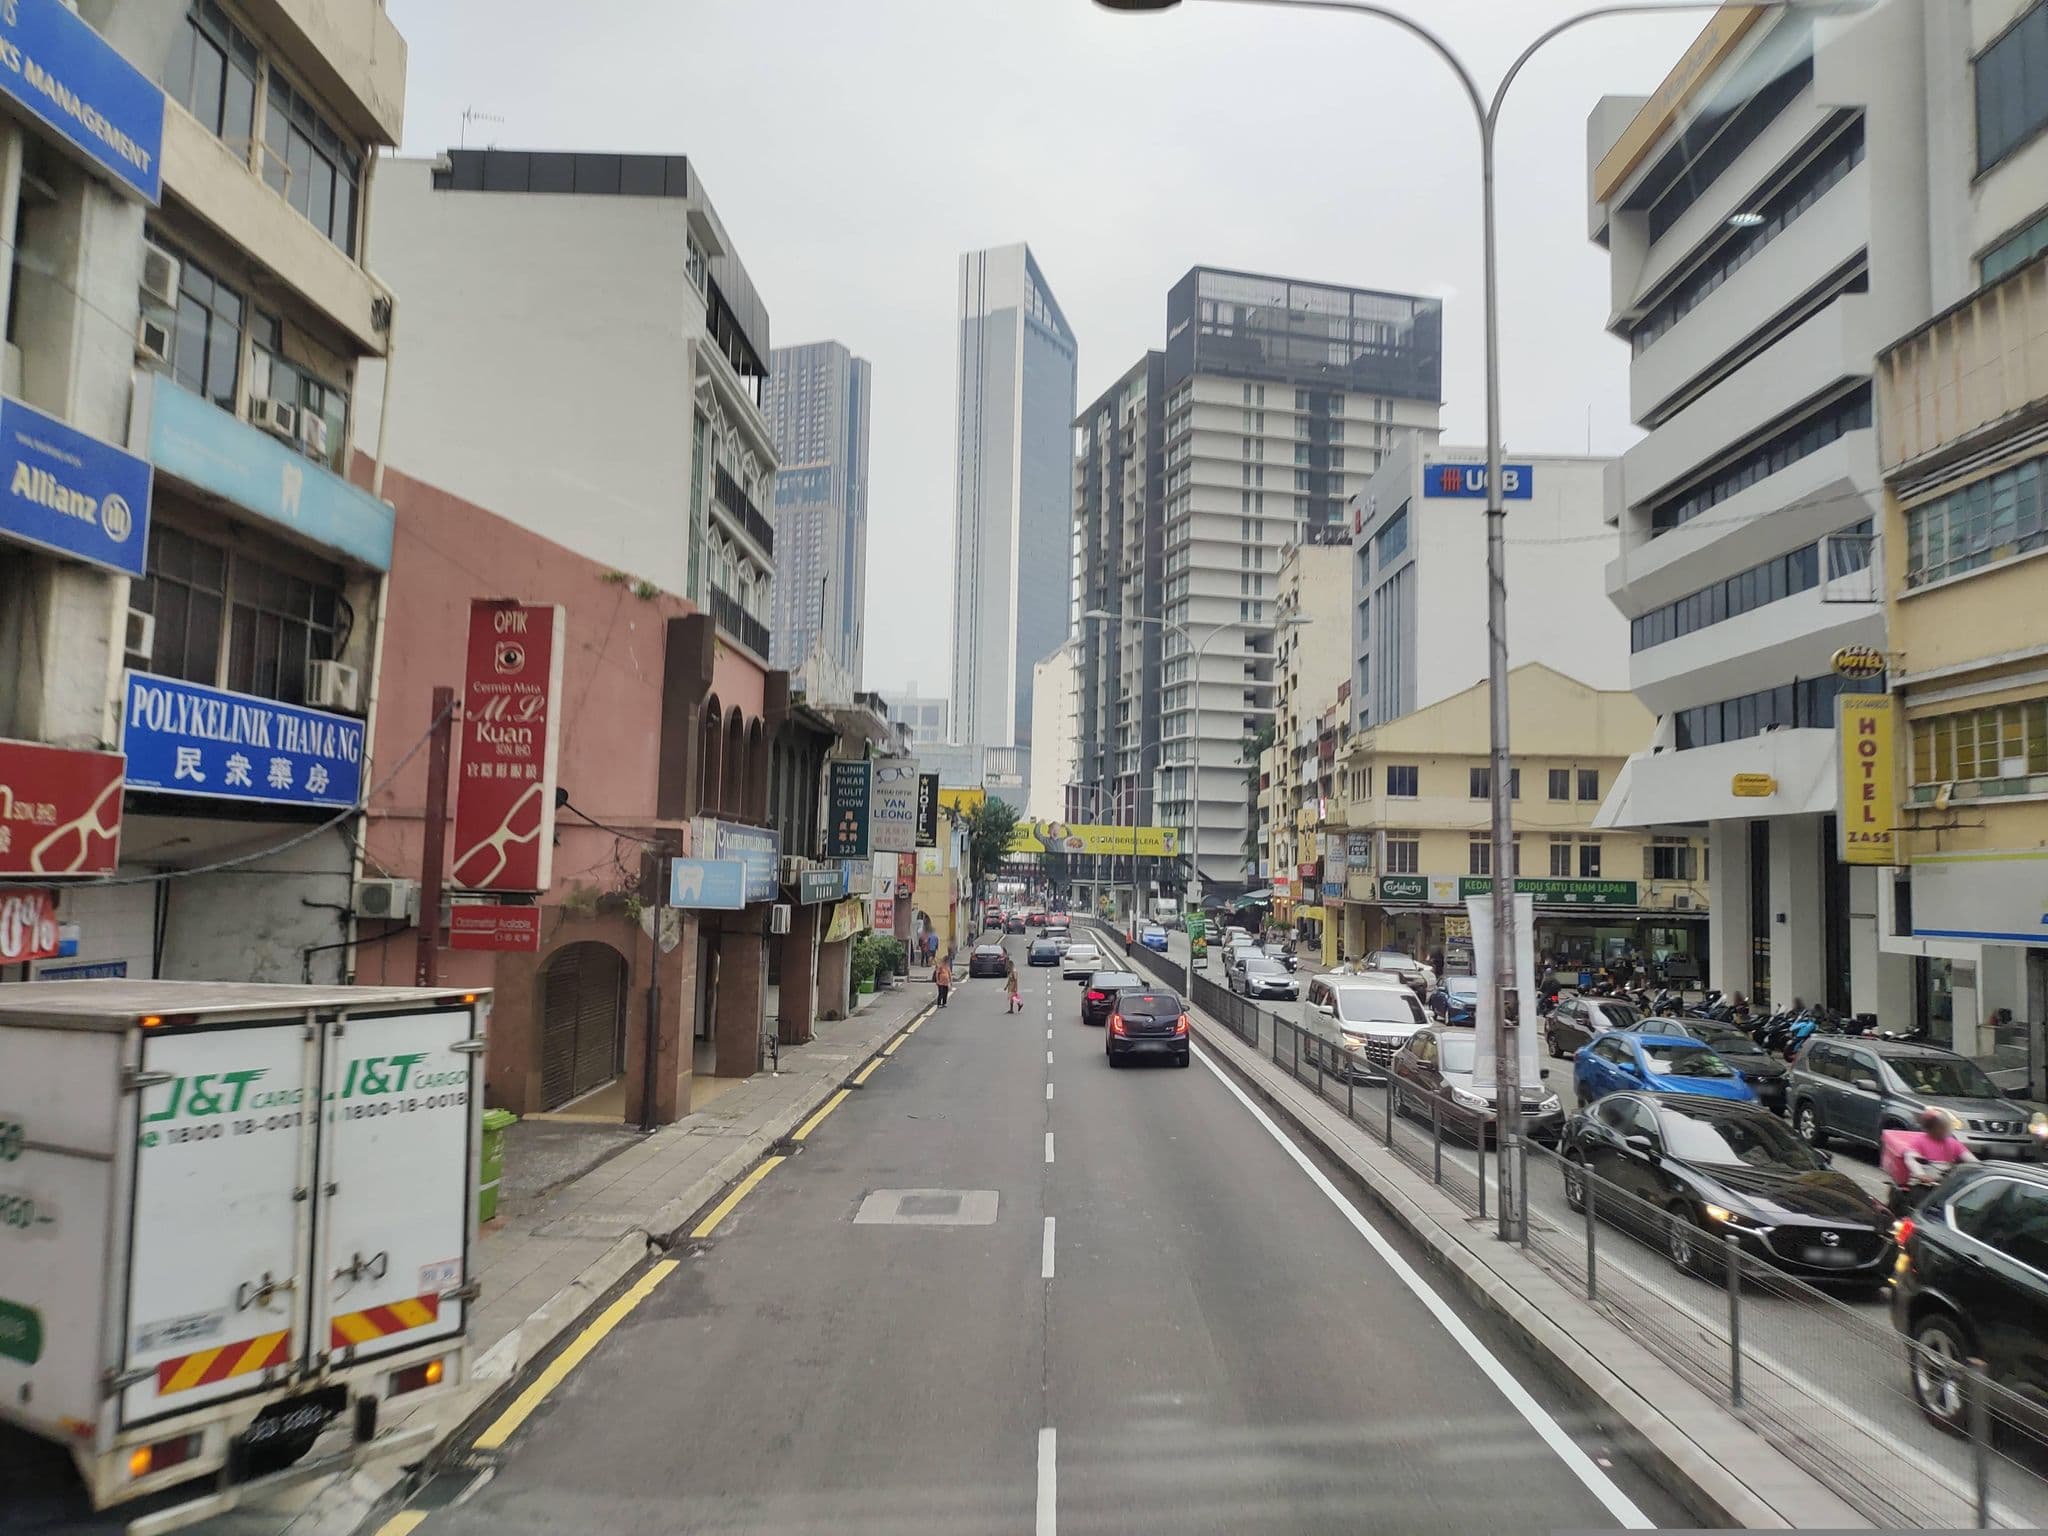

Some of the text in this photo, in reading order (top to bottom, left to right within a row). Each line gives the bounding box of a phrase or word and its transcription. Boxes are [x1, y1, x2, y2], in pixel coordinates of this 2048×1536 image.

[24, 56, 152, 175] MANAGEMENT
[1466, 469, 1519, 491] UB
[10, 460, 98, 525] Allianz
[494, 610, 528, 634] OPTIK
[131, 684, 359, 763] POLYKELINIK THAM & NG
[476, 721, 533, 745] Kuan
[836, 766, 865, 775] KLINIK
[836, 777, 864, 786] PAKAR
[1858, 717, 1877, 823] HOTEL
[836, 799, 864, 808] CHOW
[838, 788, 863, 796] KULIT
[884, 799, 906, 808] YAN
[873, 809, 913, 820] LEONG
[920, 785, 929, 832] HOTEL
[1848, 831, 1890, 843] ZASS
[1383, 880, 1422, 895] Carlsberg
[1518, 881, 1543, 891] PUDU
[1545, 882, 1568, 892] SATU
[1569, 883, 1596, 893] ENAM
[1598, 883, 1627, 893] LAPAN
[322, 1052, 468, 1100] J&T CARGO
[141, 1068, 271, 1123] J&T
[344, 1091, 468, 1121] 1800-18-0018
